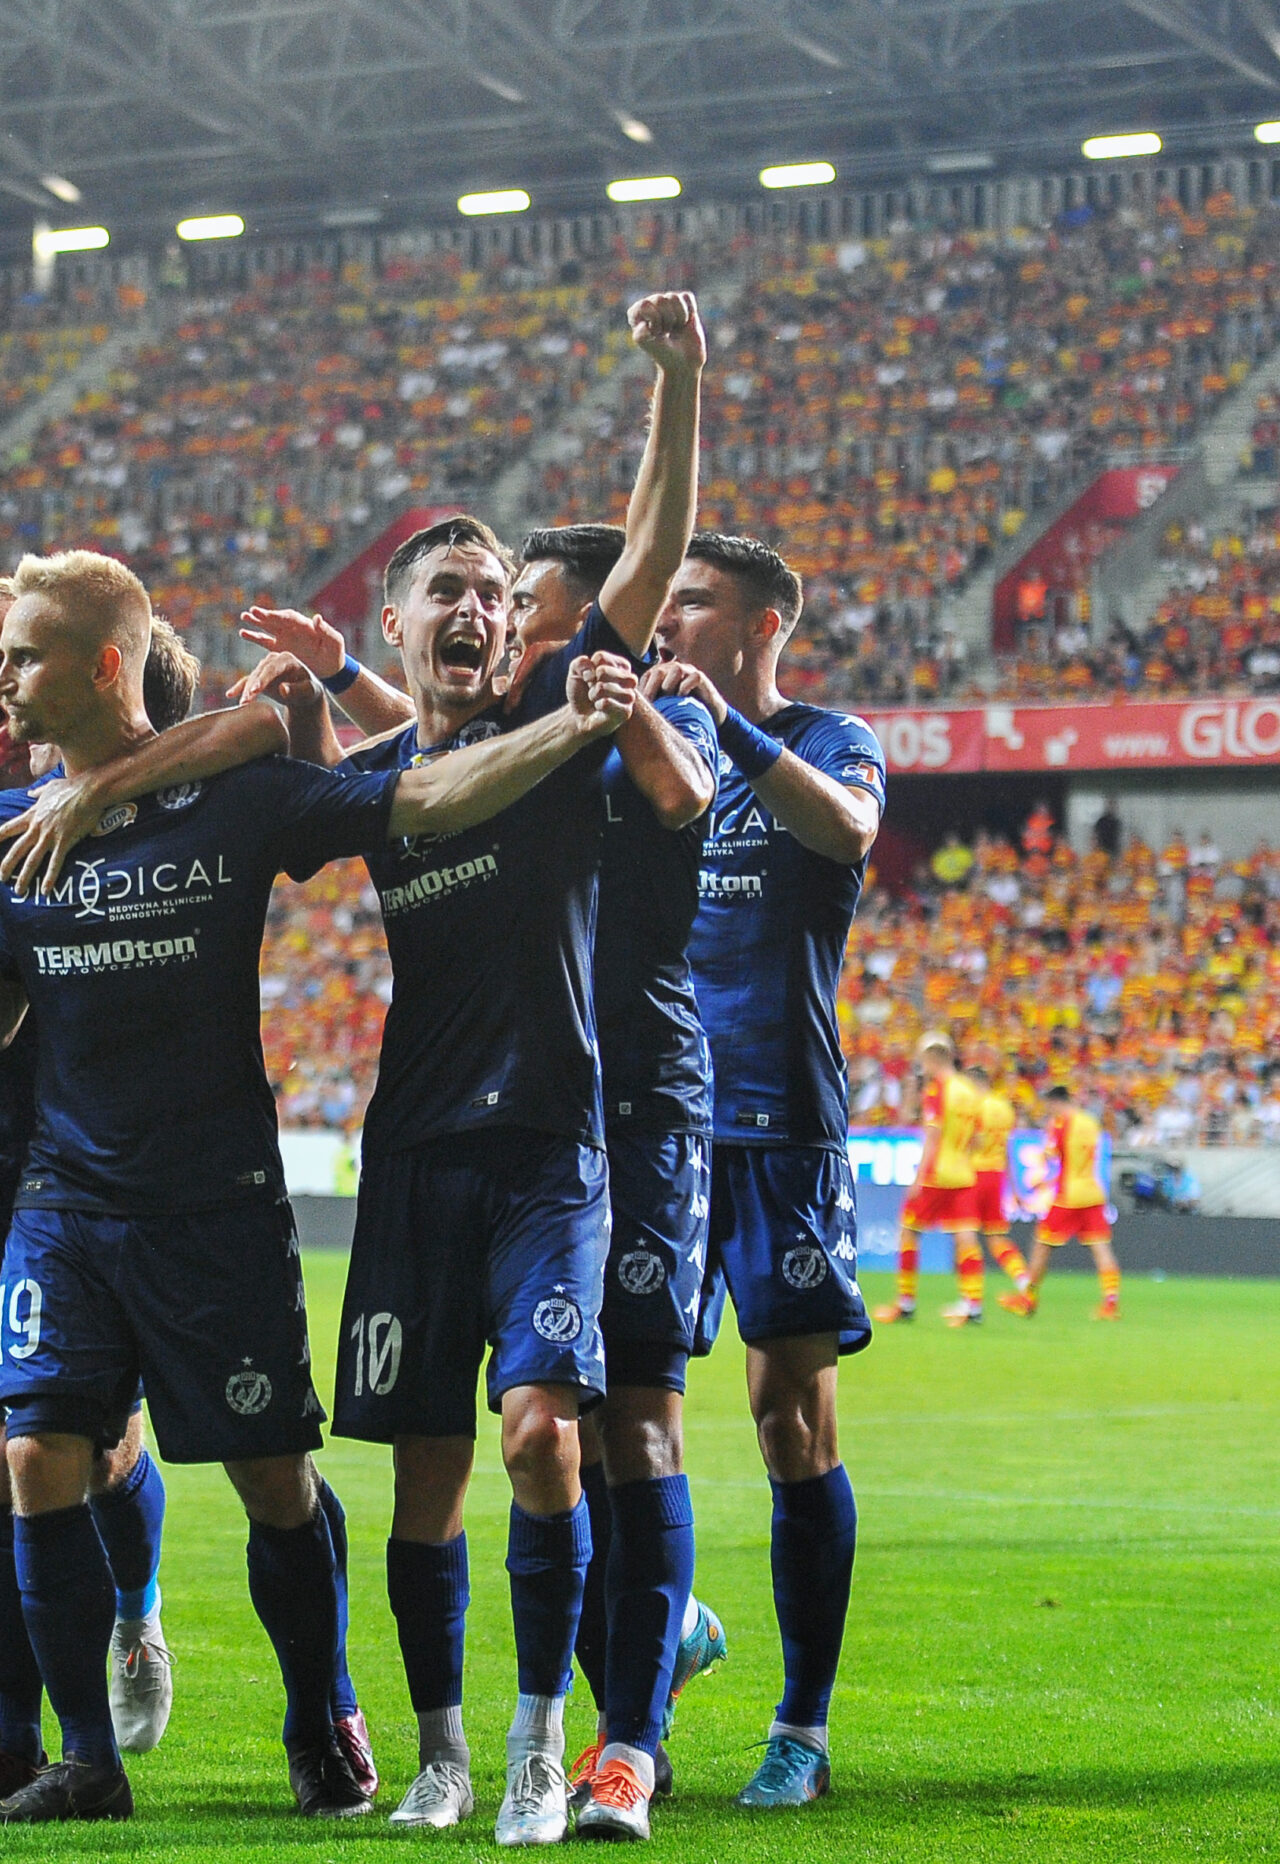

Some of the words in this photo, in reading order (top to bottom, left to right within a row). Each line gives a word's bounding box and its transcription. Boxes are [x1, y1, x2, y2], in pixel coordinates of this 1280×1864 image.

[100, 808, 127, 830] LOTTO
[702, 849, 734, 857] OSTYKA
[722, 839, 769, 848] KLINICZNA
[108, 901, 160, 914] MEDYCYNA
[163, 894, 213, 906] KLINICZNA
[109, 908, 177, 922] DIAGNOSTYKA
[33, 936, 197, 968] TERMOton
[38, 950, 198, 976] www.owczary.pl
[351, 1312, 403, 1396] 10
